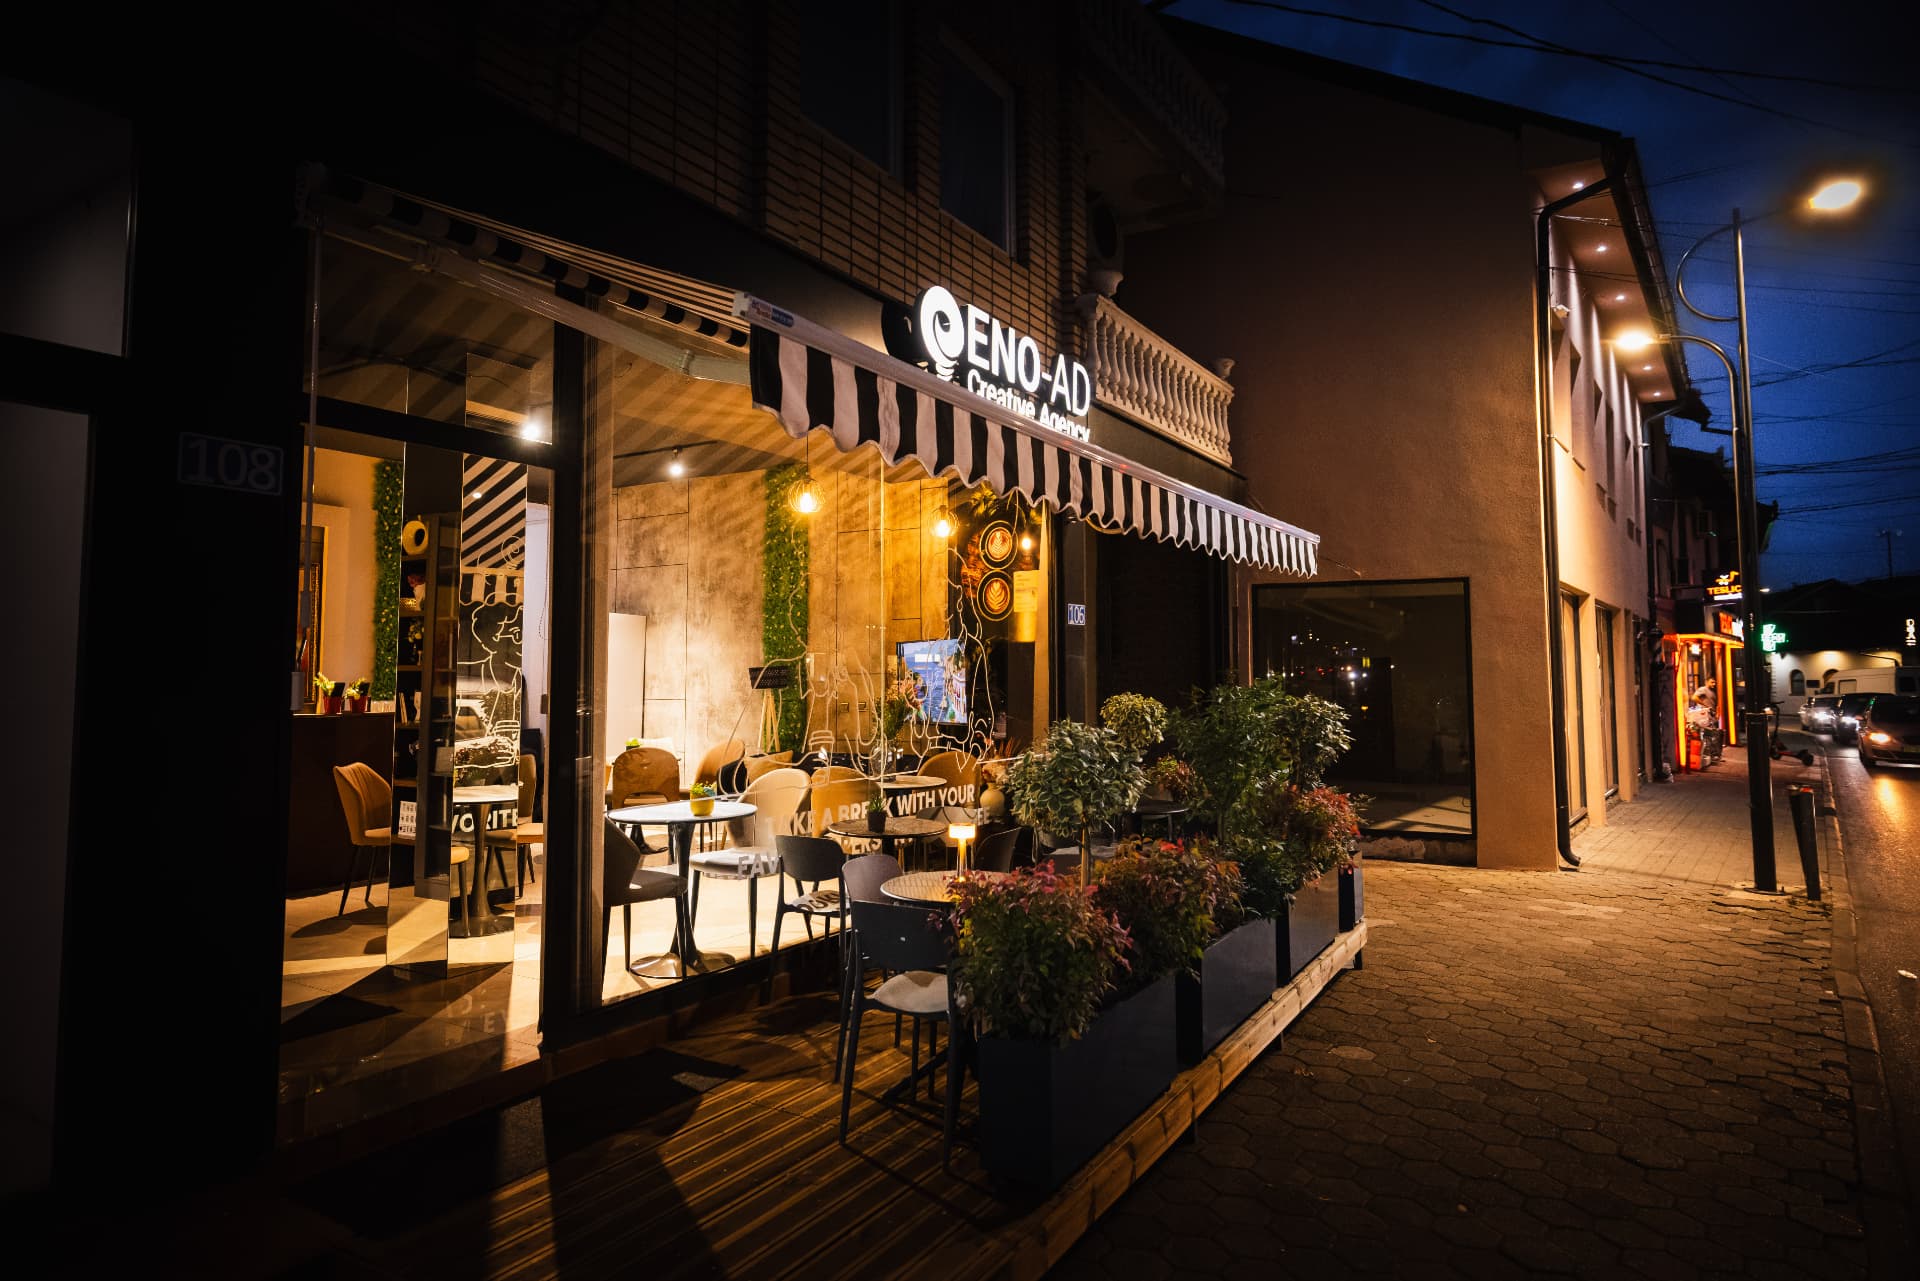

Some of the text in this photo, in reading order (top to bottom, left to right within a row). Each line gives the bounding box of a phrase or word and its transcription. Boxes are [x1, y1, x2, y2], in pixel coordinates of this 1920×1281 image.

[967, 304, 1091, 417] ENO-AD
[967, 369, 1091, 442] Creative Agency
[185, 439, 276, 491] 108
[1070, 603, 1085, 624] 106
[820, 807, 834, 831] A
[838, 797, 894, 822] BREK
[896, 791, 936, 817] WITH
[938, 784, 976, 808] YOUR
